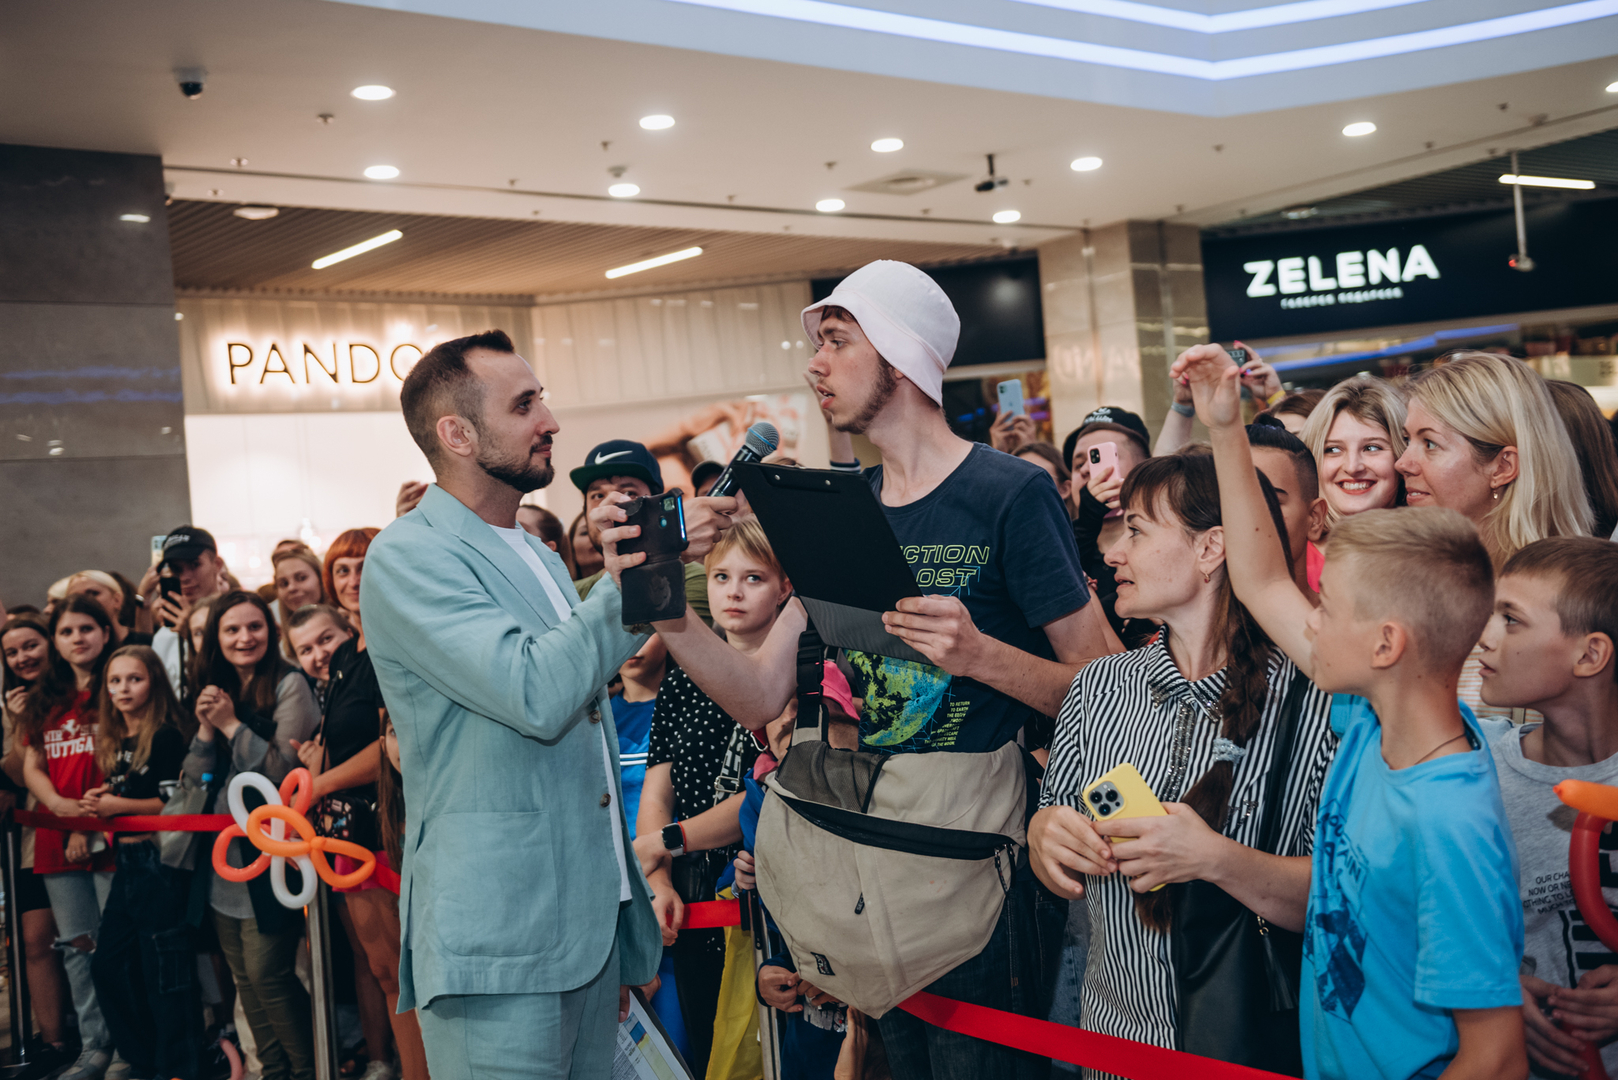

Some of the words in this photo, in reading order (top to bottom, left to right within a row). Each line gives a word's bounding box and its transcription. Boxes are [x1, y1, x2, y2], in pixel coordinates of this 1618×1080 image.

[1243, 244, 1441, 297] ZELENA
[227, 343, 424, 385] PANDO
[900, 544, 990, 565] CTION
[916, 568, 977, 587] OST
[44, 735, 95, 759] TUTTGA
[1535, 875, 1552, 884] OUR
[1553, 871, 1570, 880] CHA
[1528, 886, 1546, 896] NOW
[1547, 884, 1559, 892] OR
[1560, 880, 1572, 889] NE
[1522, 895, 1551, 908] OTHING
[1551, 893, 1564, 901] TO
